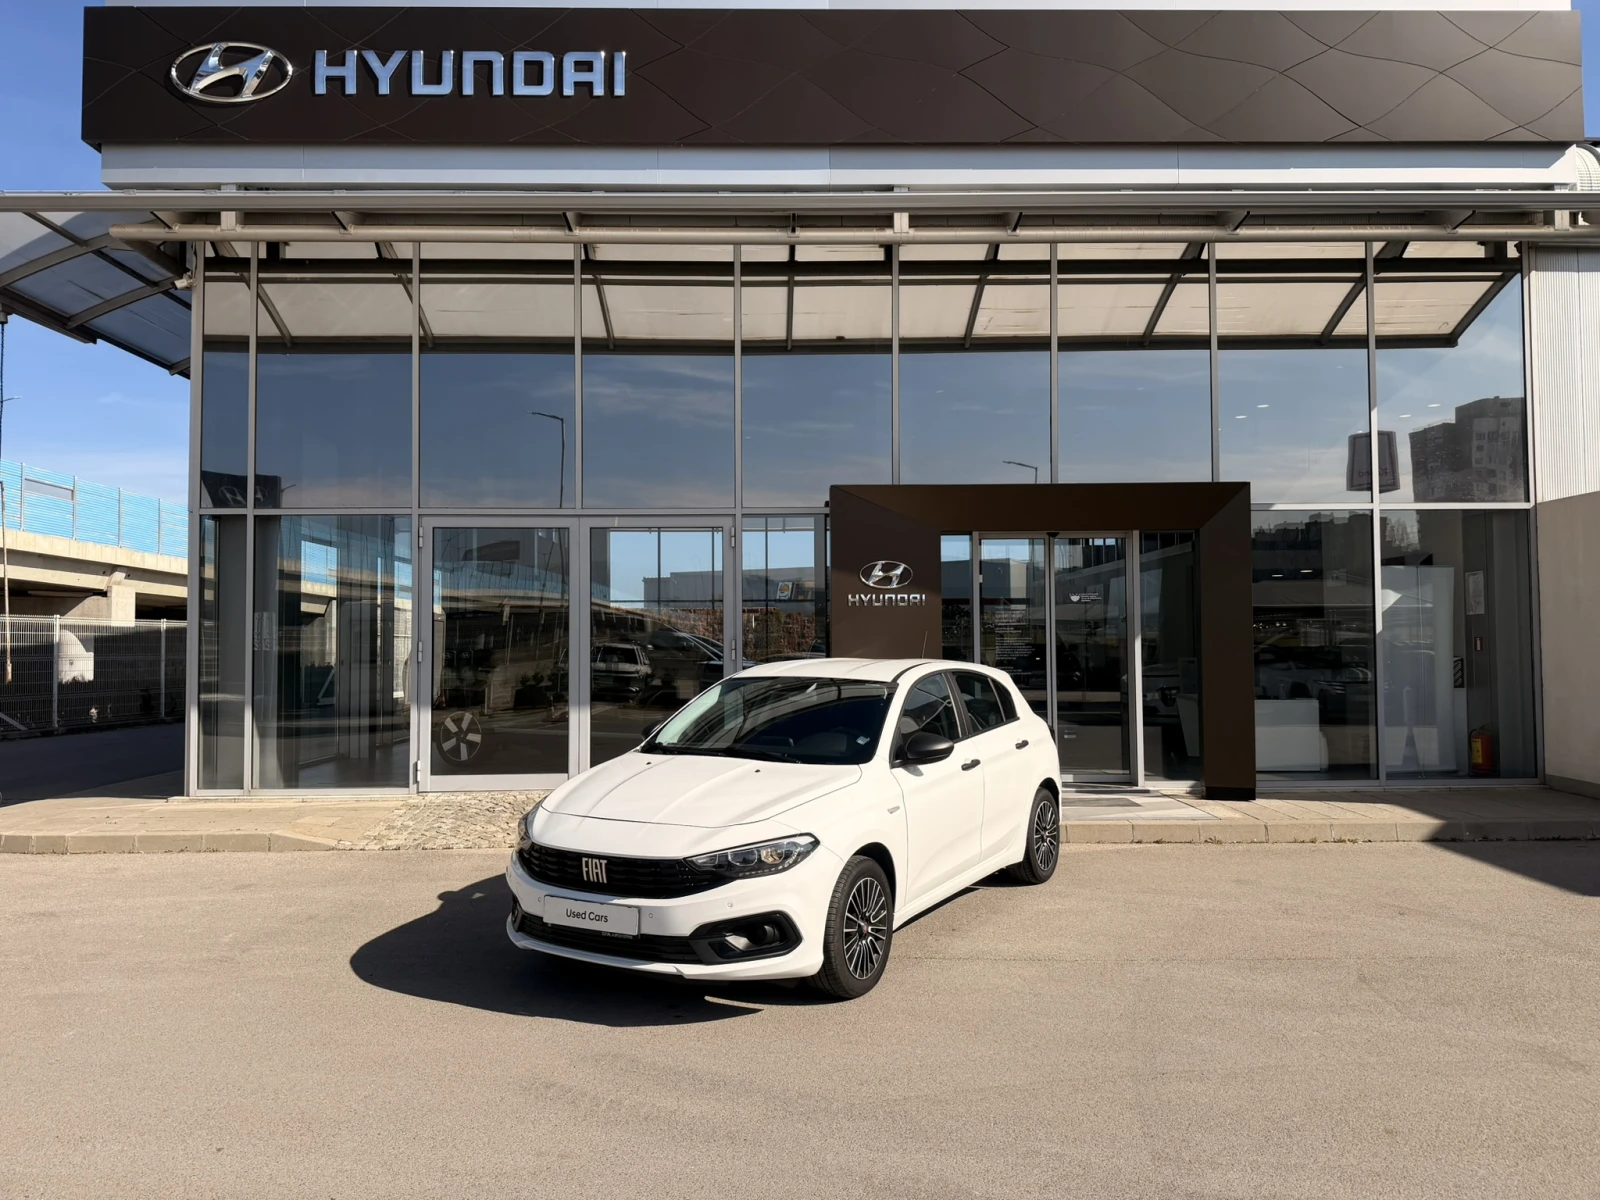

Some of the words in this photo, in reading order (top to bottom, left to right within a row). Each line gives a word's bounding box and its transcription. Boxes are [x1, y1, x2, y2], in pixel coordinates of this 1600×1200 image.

[315, 49, 626, 96] HYUNDAI
[848, 593, 926, 607] HYUNDAI
[582, 857, 607, 883] FIAT
[566, 908, 587, 920] Used
[588, 911, 608, 922] Cars
